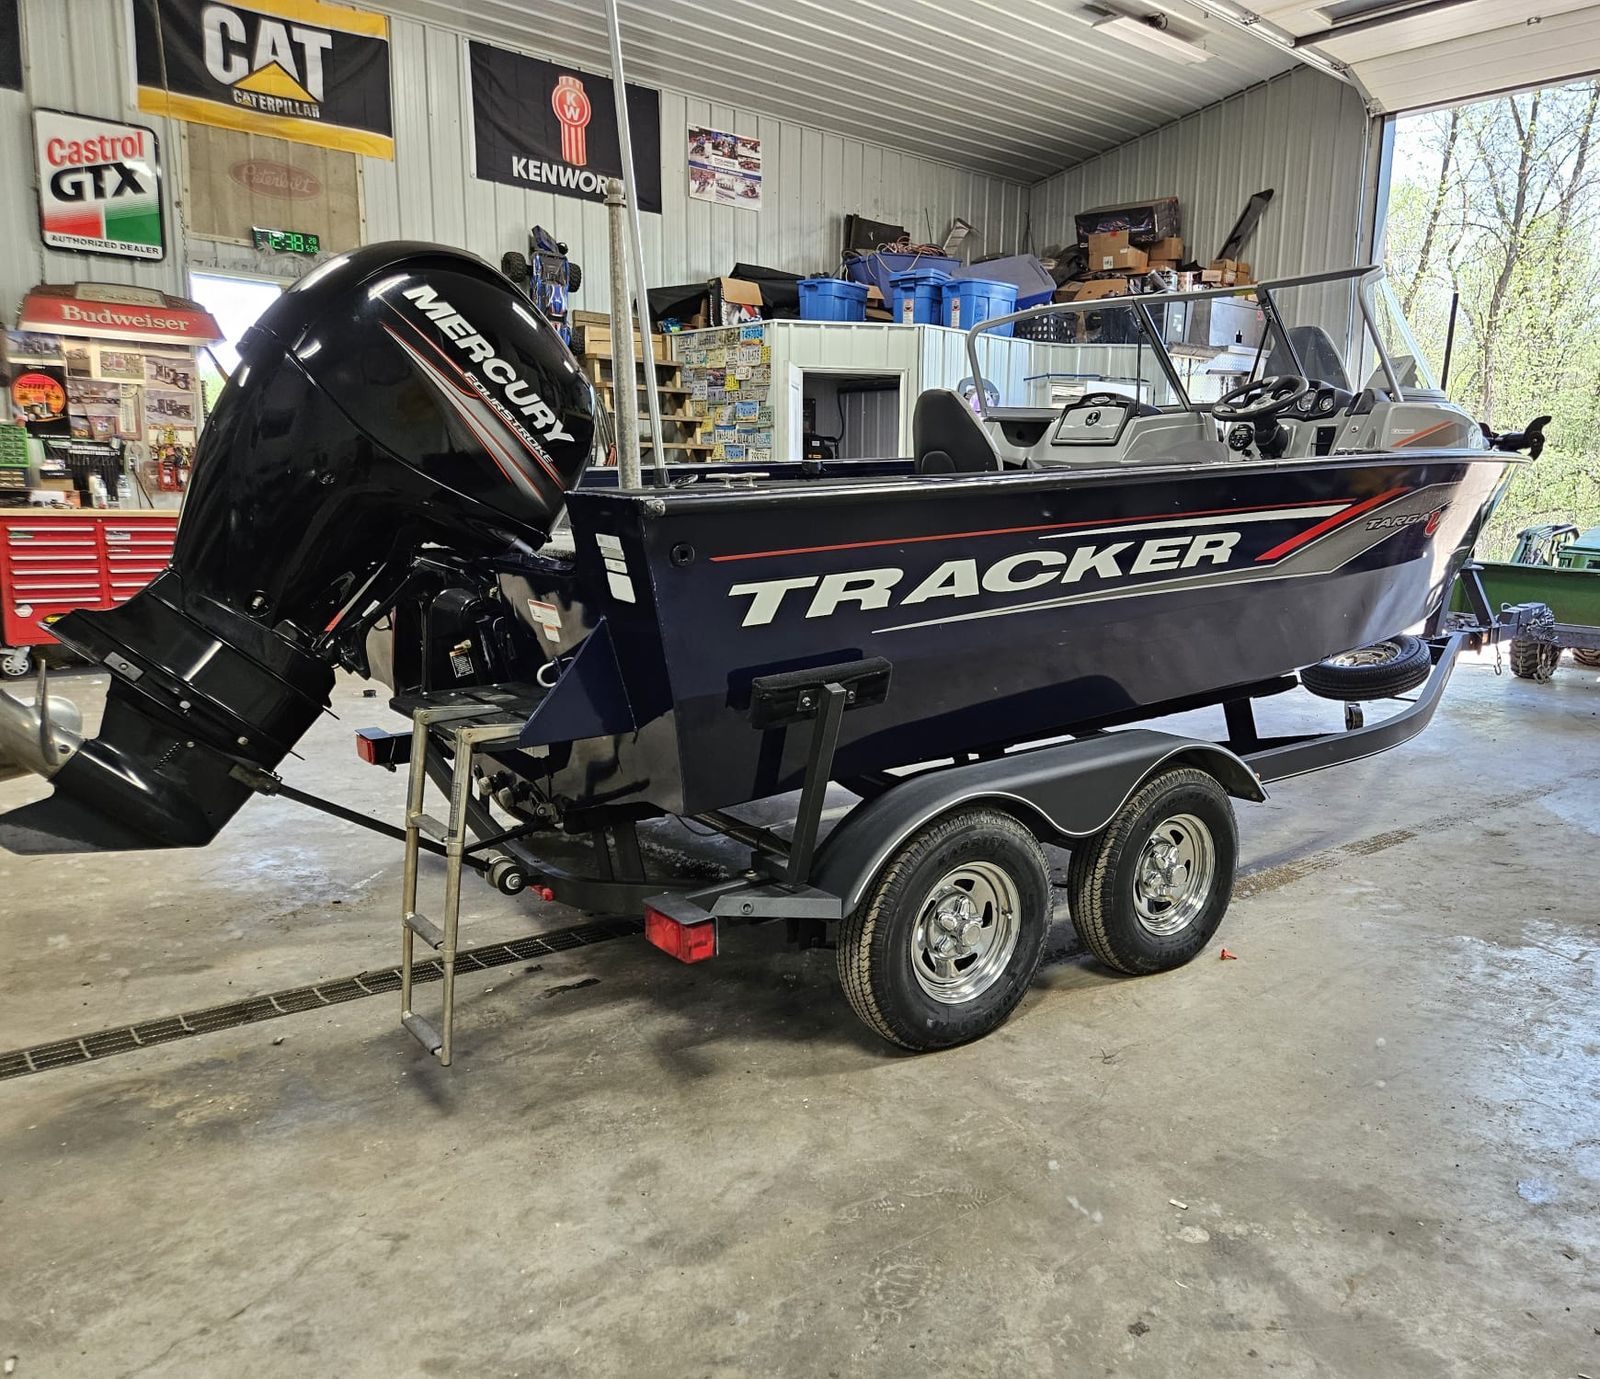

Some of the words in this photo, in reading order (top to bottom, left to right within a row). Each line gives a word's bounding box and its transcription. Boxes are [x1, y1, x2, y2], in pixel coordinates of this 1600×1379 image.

[202, 6, 332, 103] CAT
[233, 87, 321, 119] CATERPILLAR
[47, 131, 145, 167] Castrol
[50, 162, 147, 203] GTX
[511, 156, 626, 197] KENWOR
[51, 234, 117, 250] AUTHORIZED
[119, 241, 159, 255] DEALER
[60, 304, 190, 331] Budweiser
[402, 284, 575, 443] MERCURY
[463, 371, 554, 464] FOURSTROKE
[1366, 511, 1430, 531] TARGA
[728, 531, 1242, 628] TRACKER
